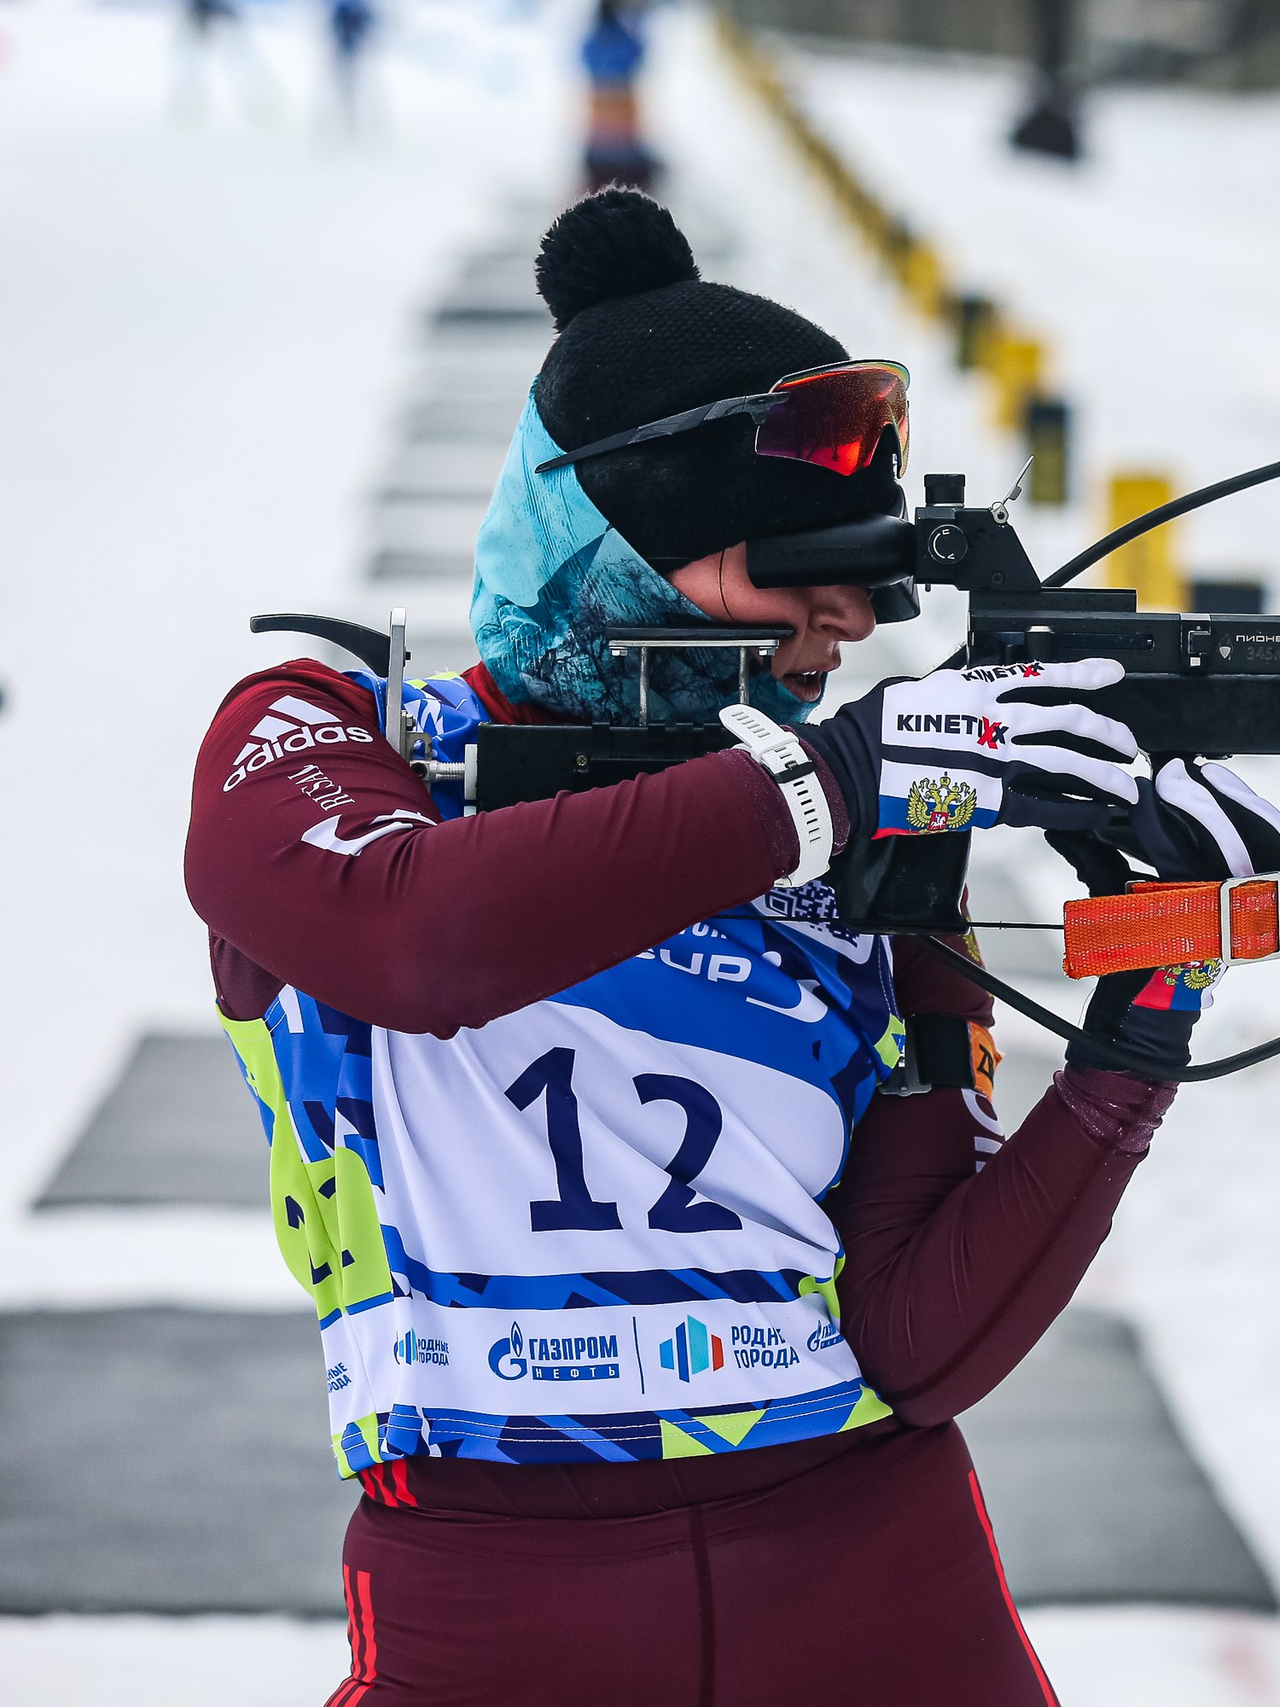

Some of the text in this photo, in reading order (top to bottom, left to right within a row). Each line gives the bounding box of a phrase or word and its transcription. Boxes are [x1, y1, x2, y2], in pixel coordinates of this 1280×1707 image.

[222, 725, 374, 792] adidas
[636, 947, 752, 983] UP
[504, 1046, 743, 1234] 12
[528, 1334, 619, 1361] ГАЗПРОМ
[733, 1345, 800, 1369] ГОРОДА
[535, 1365, 616, 1380] НЕФТЬ
